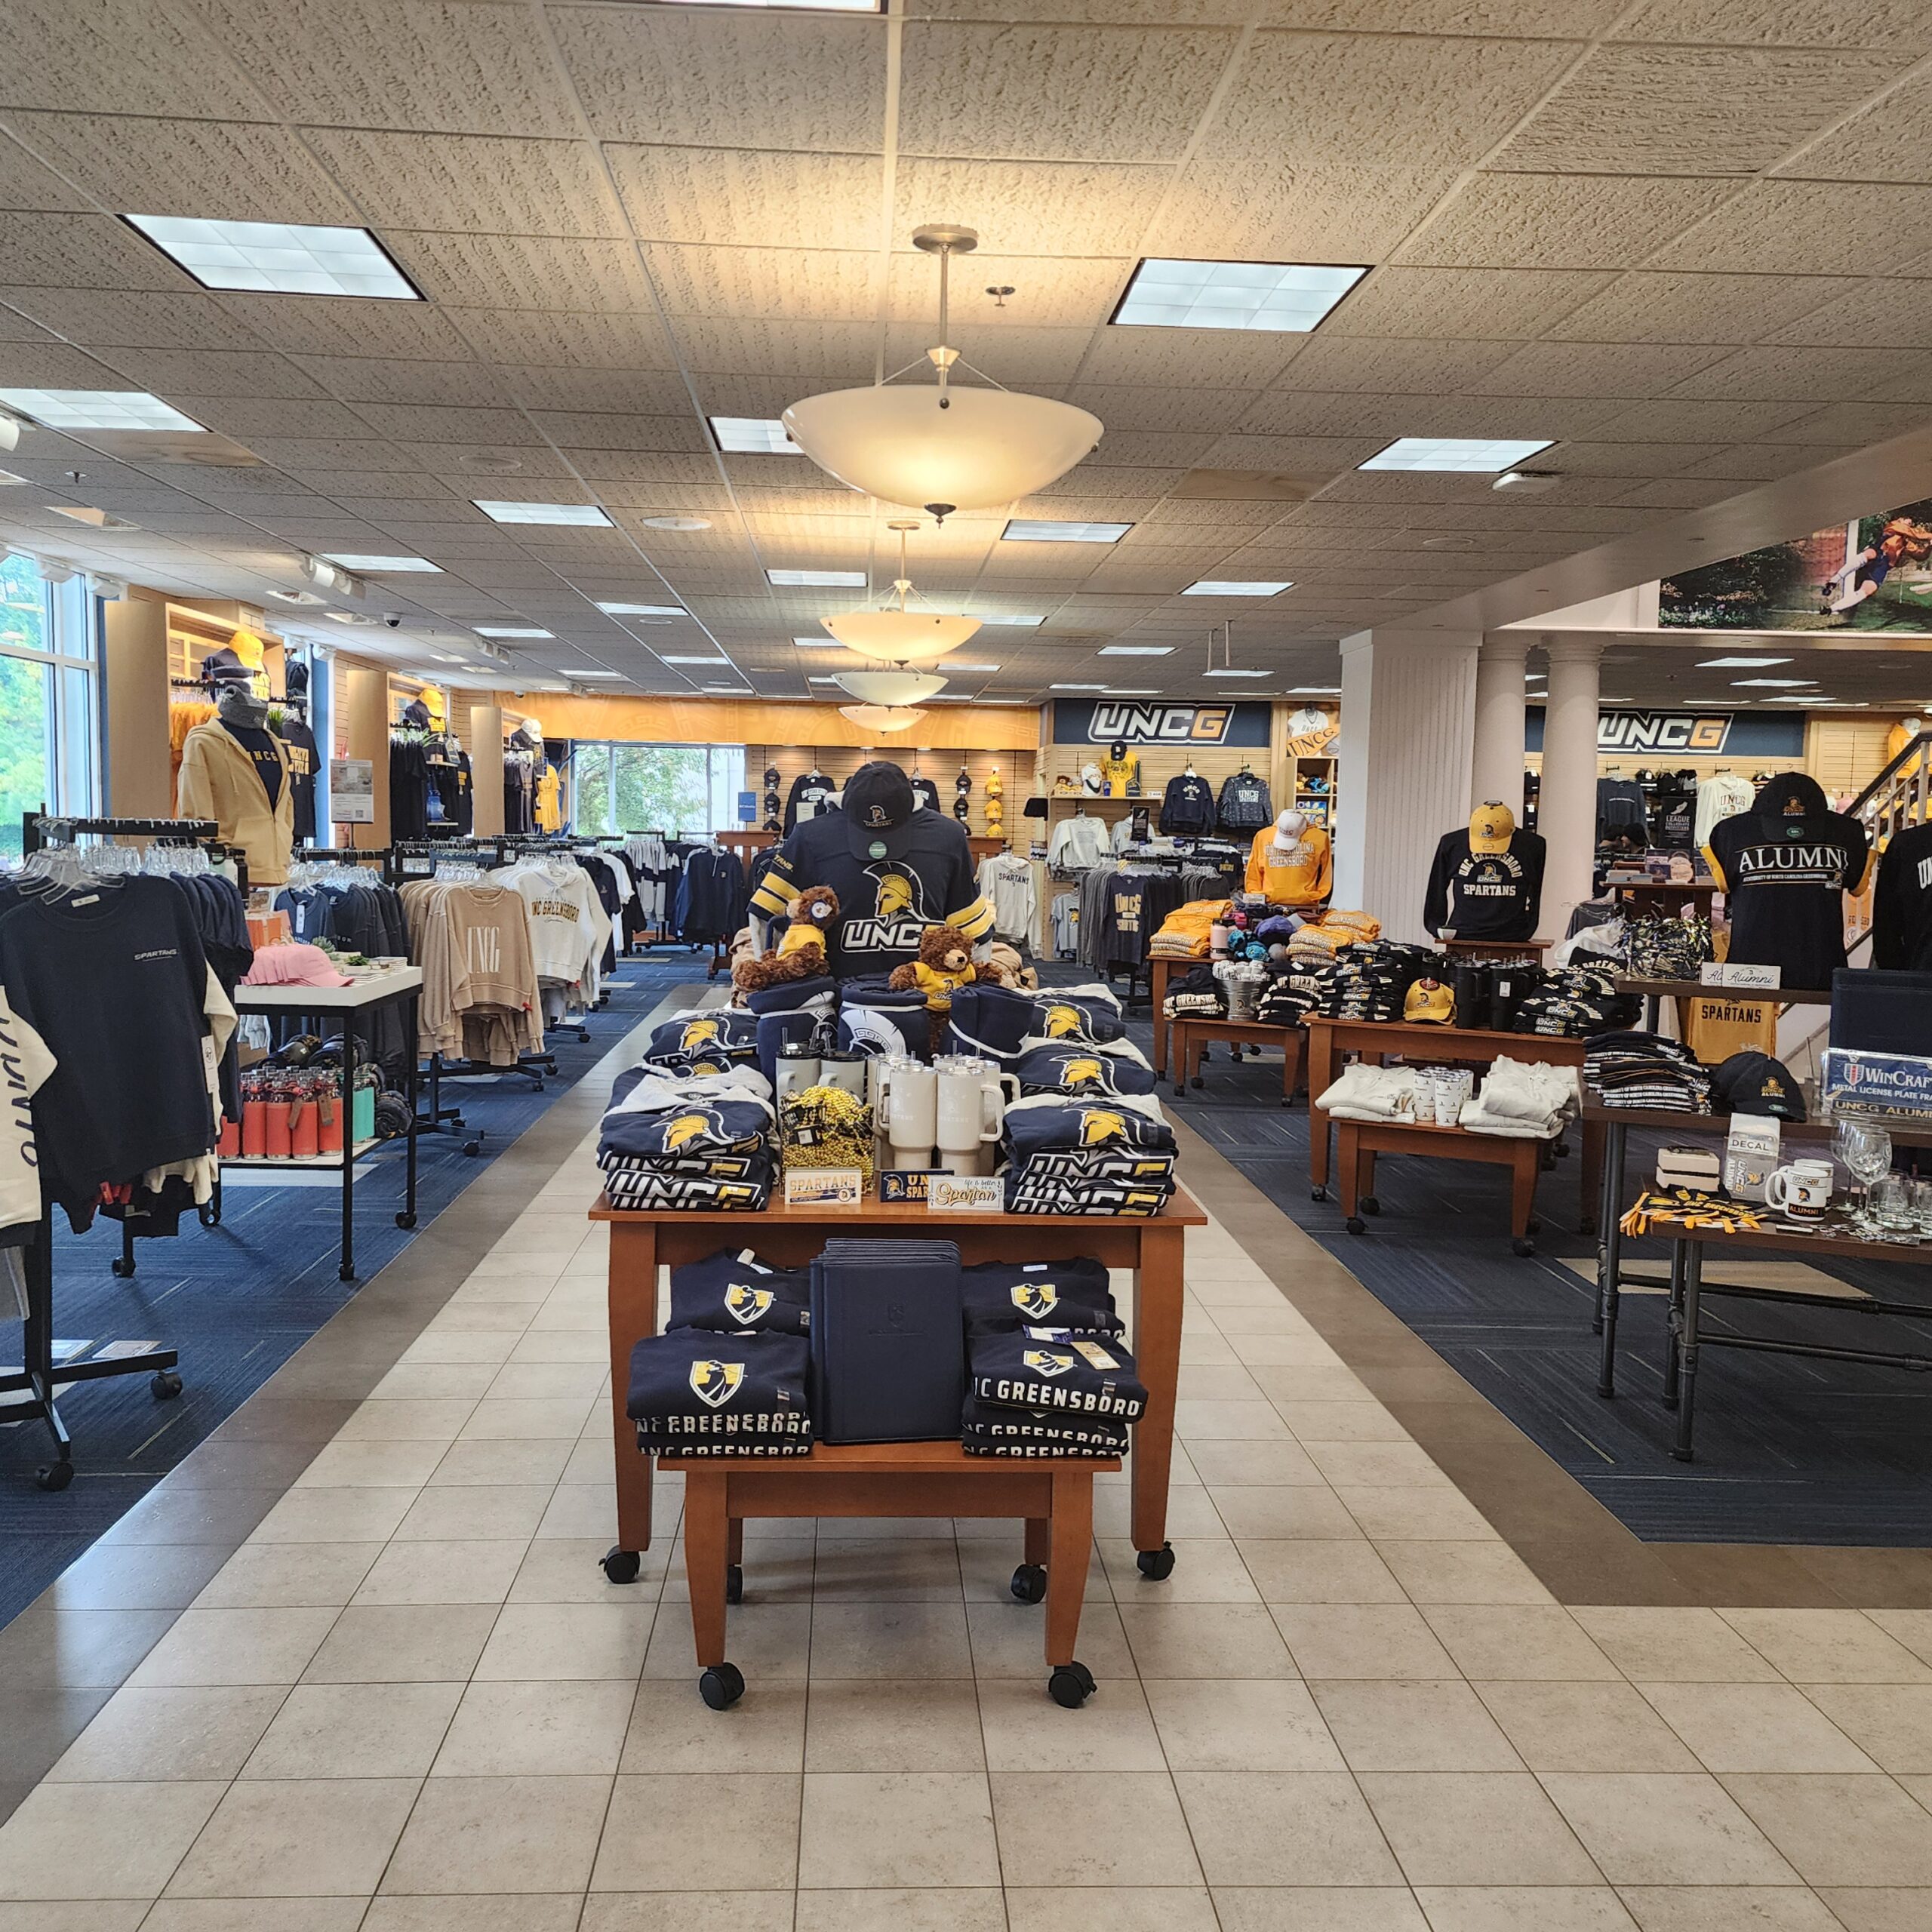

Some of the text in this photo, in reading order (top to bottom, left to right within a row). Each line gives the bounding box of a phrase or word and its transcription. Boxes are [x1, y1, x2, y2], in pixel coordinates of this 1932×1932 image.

[1091, 706, 1232, 740] UNCG
[1598, 715, 1727, 747] UNCG
[1288, 728, 1337, 756] UNCG
[1238, 789, 1260, 798] UNCG
[1721, 794, 1746, 807] UNCG
[1269, 854, 1300, 868] GREENSBORO
[1458, 858, 1475, 877] UNC
[998, 872, 1030, 885] SPARTANS
[1477, 875, 1503, 883] UNCG
[1463, 884, 1516, 897] SPARTANS
[543, 900, 580, 923] GREENSBORO
[843, 921, 945, 950] UNC
[134, 948, 178, 960] SPARTANS
[1727, 971, 1775, 984] Alumni
[1546, 1005, 1578, 1019] UNCG
[1701, 1004, 1761, 1023] SPARTANS
[1535, 1017, 1566, 1027] UNCG
[1534, 1025, 1565, 1035] UNCG
[1832, 1083, 1857, 1093] METAL
[1859, 1087, 1892, 1097] LICENSE
[1894, 1091, 1917, 1100] PLATE
[1835, 1100, 1880, 1113] UNCG
[1731, 1139, 1769, 1151] DECAL
[789, 1174, 857, 1192] SPARTANS
[980, 1178, 997, 1186] better
[1736, 1159, 1747, 1194] UNCG
[1792, 1177, 1820, 1186] UNCG
[935, 1182, 997, 1207] Spartan
[1789, 1205, 1819, 1216] ALUMNI
[997, 1380, 1142, 1417] GREENSBORO
